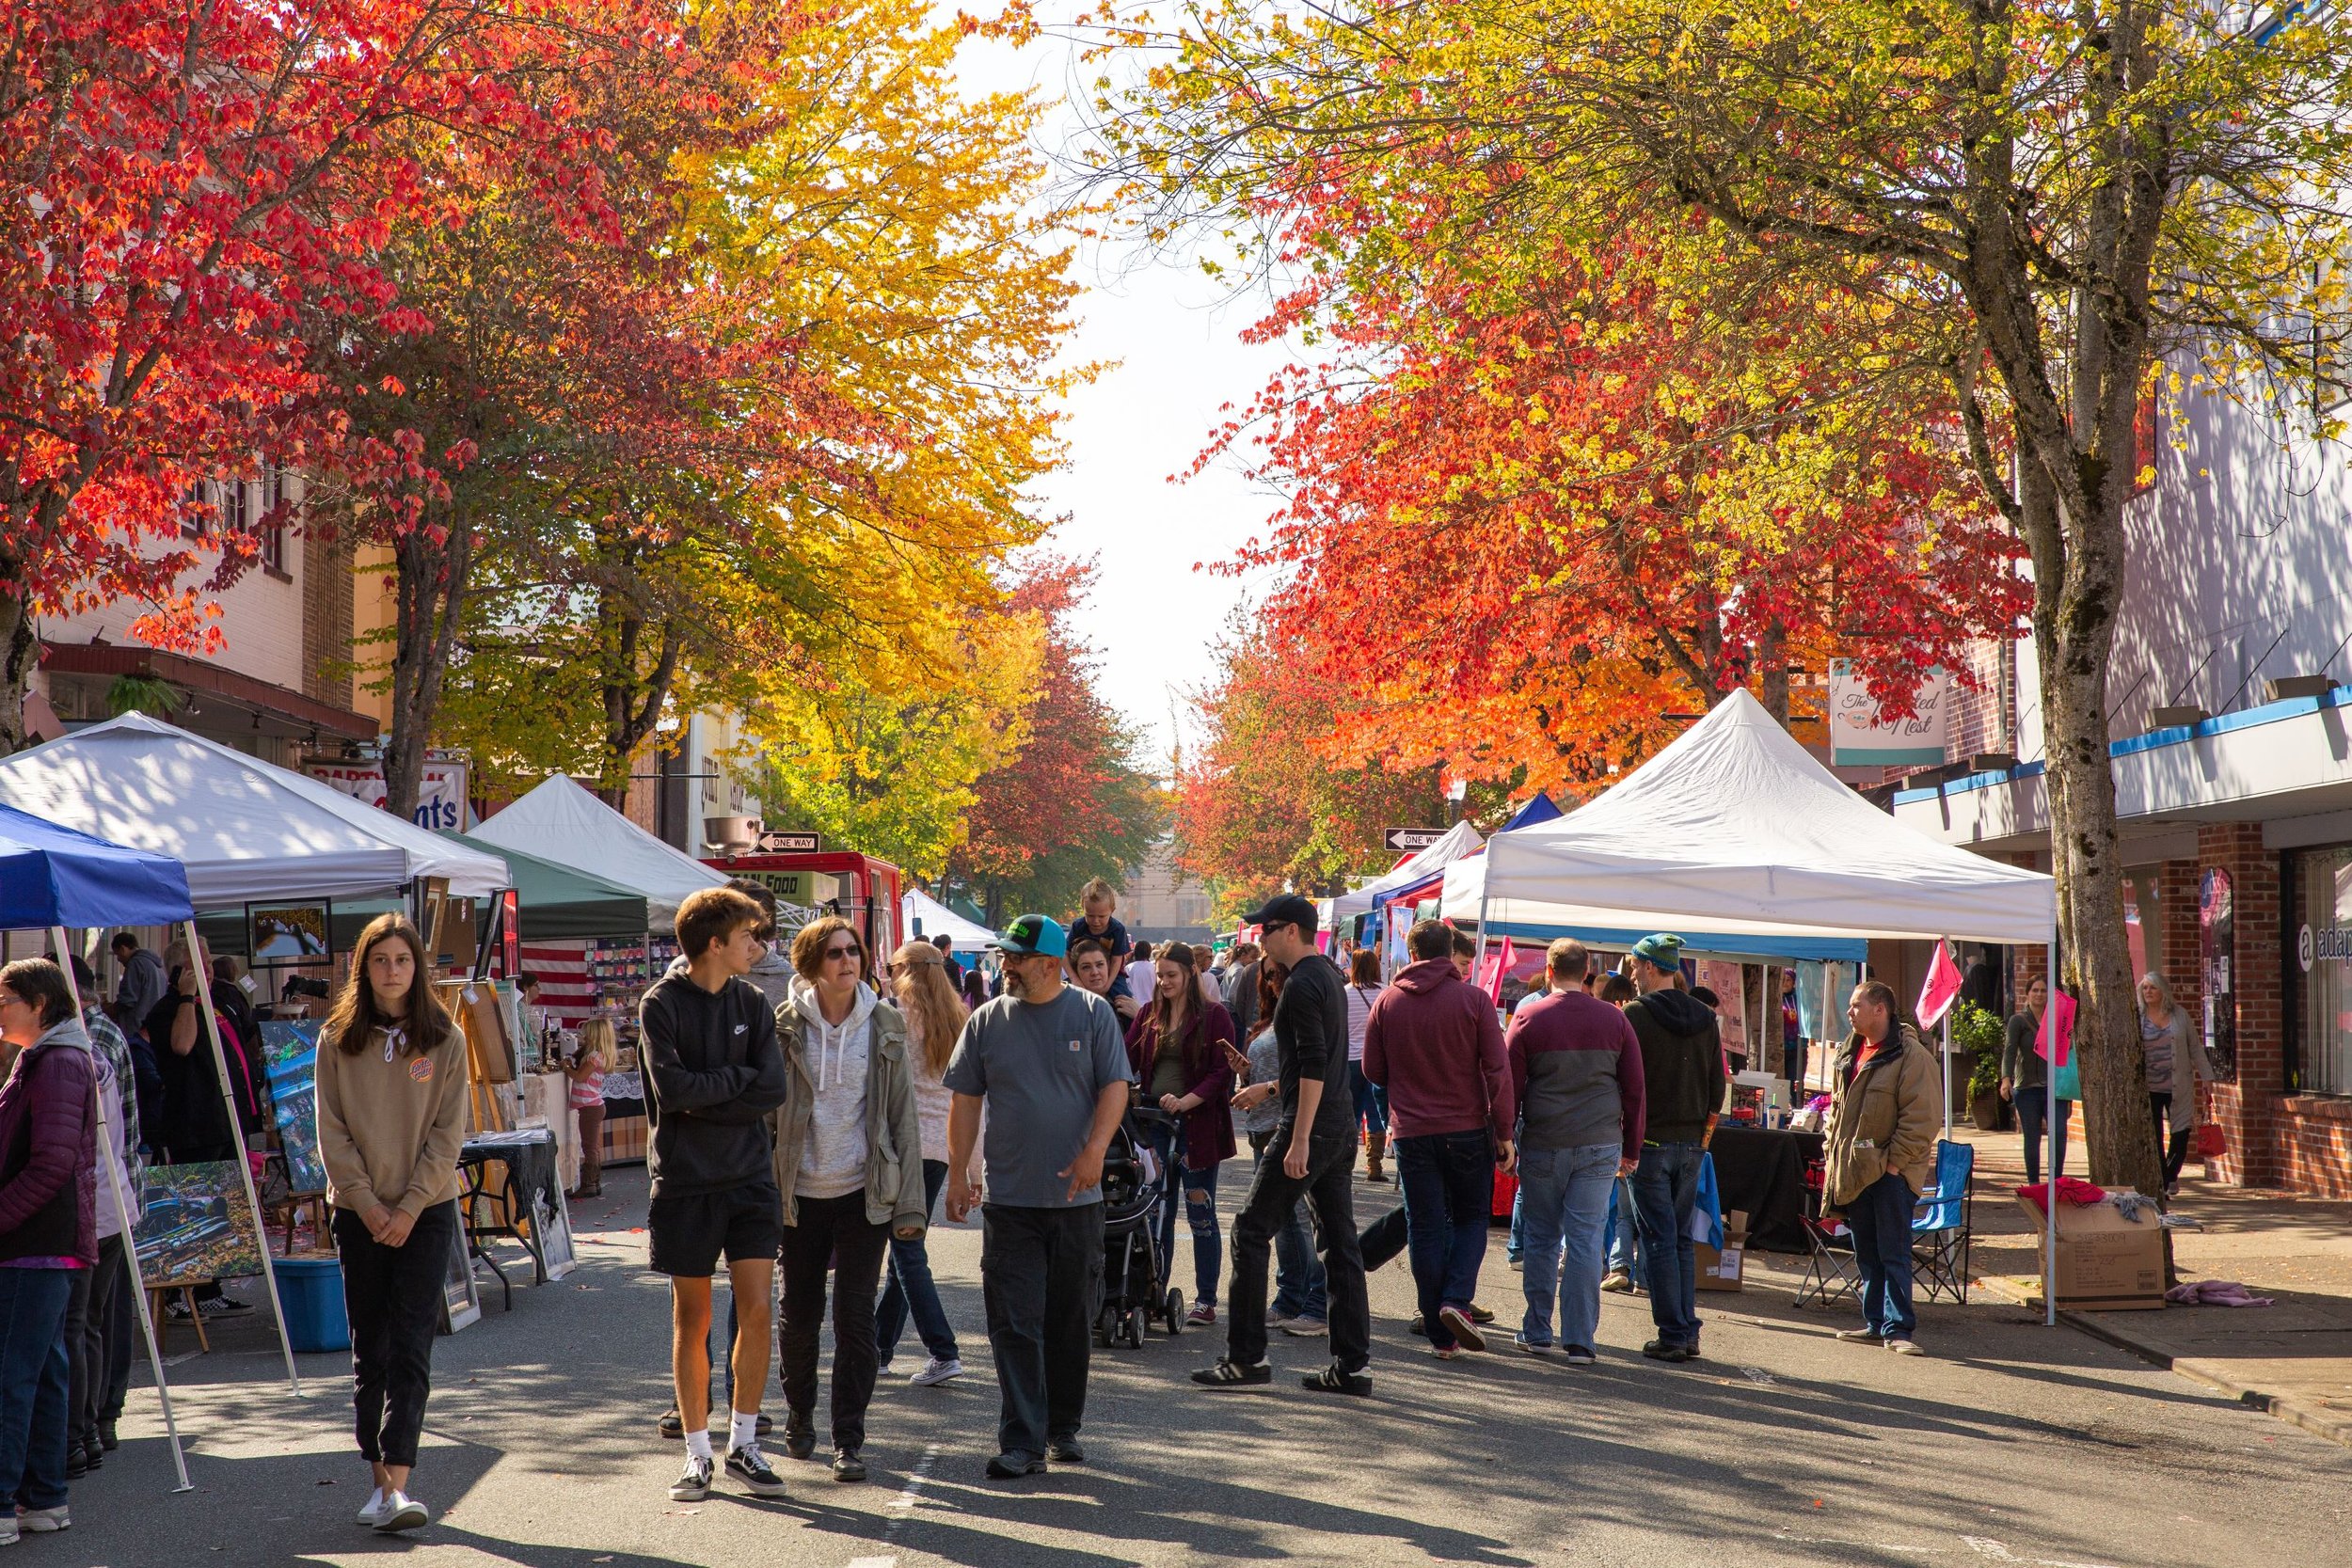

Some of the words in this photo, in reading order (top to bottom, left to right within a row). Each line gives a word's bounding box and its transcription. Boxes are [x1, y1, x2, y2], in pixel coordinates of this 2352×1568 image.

[1841, 693, 1867, 709] The
[1882, 715, 1932, 736] Nest
[773, 838, 791, 847] ONE
[794, 838, 813, 847] WAY
[1405, 835, 1423, 845] ONE
[1425, 835, 1441, 845] WA
